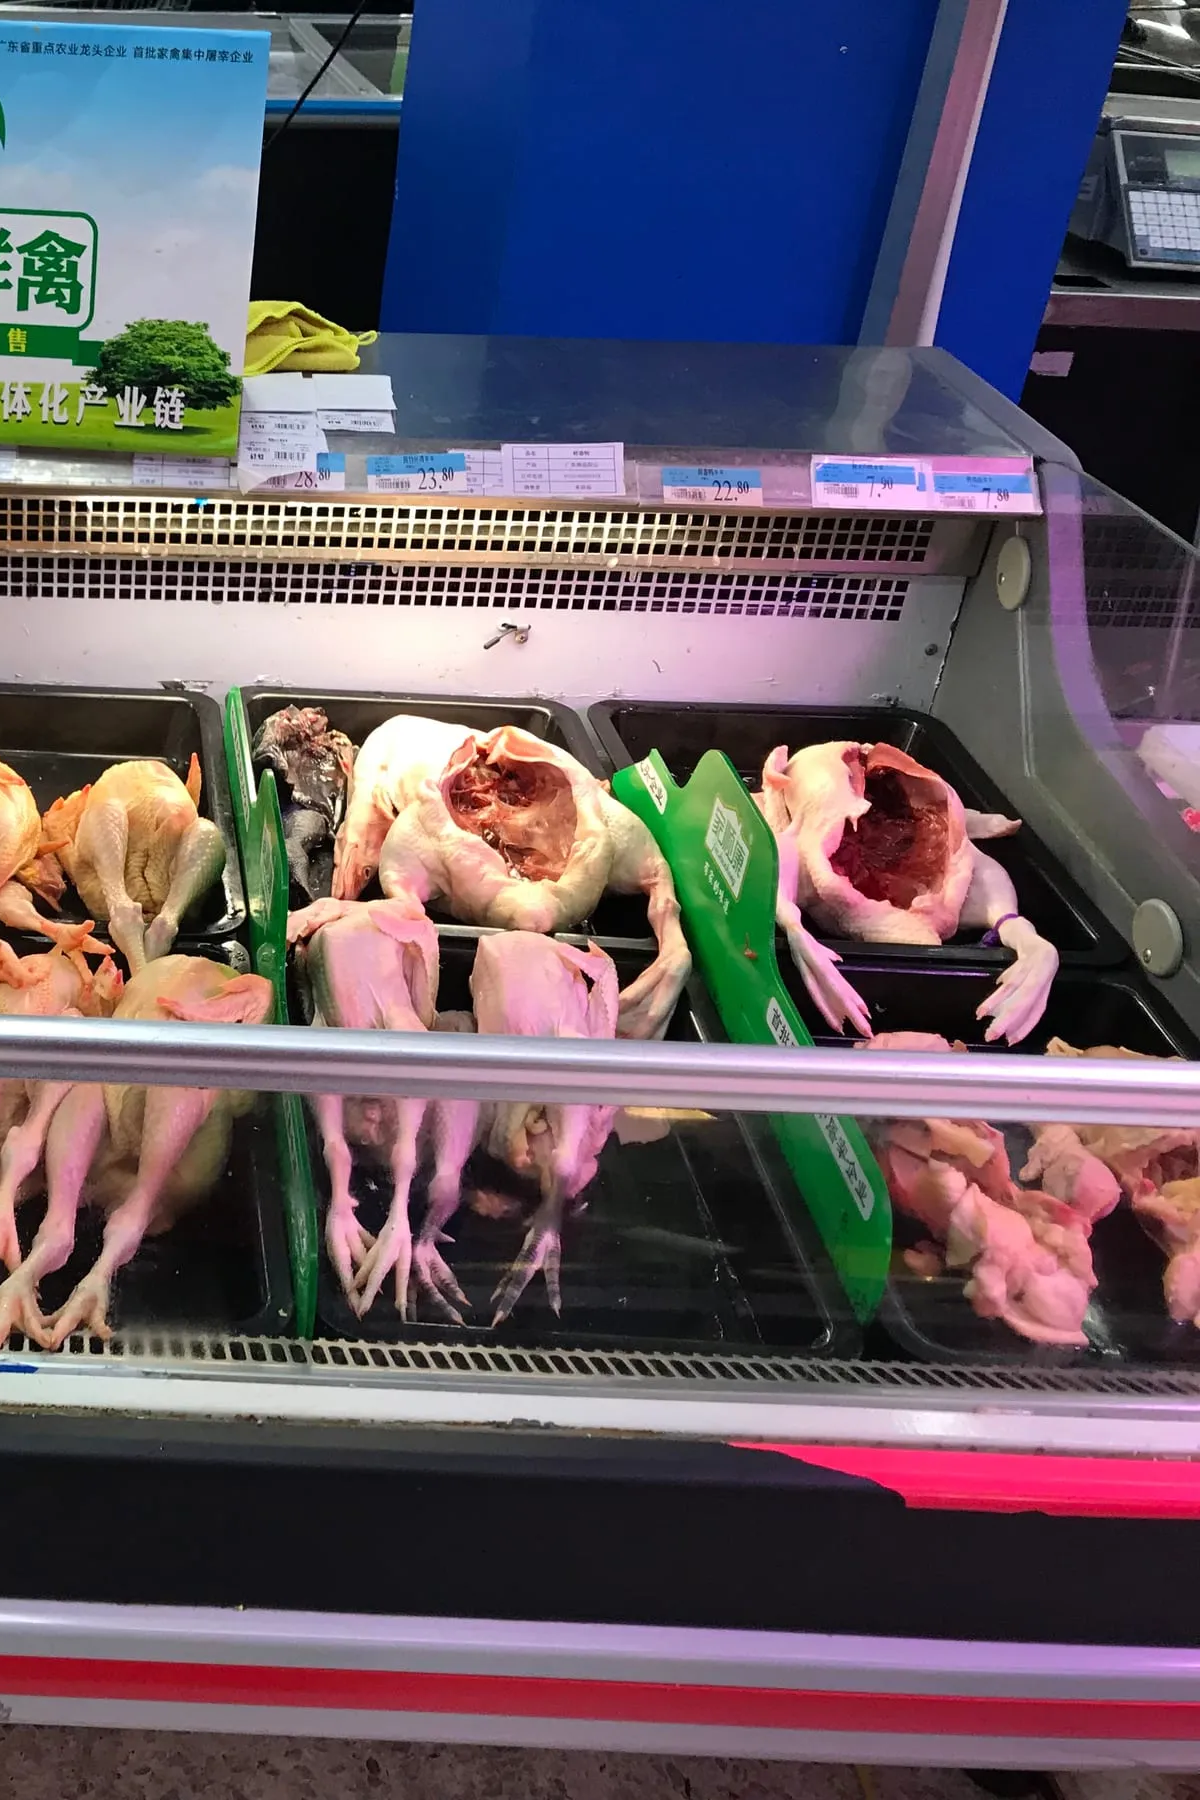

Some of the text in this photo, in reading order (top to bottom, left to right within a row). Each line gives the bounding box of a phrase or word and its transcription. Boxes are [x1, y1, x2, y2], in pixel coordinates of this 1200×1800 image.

[133, 47, 253, 63] 首批家禽集中屠宰企业
[294, 467, 331, 488] 28.80
[418, 467, 454, 490] 23.80
[867, 476, 893, 497] 7.90
[712, 480, 749, 501] 22.80
[982, 487, 1009, 509] 7.80
[772, 1007, 796, 1048] 首批
[820, 1115, 866, 1208] 屠宰企业
